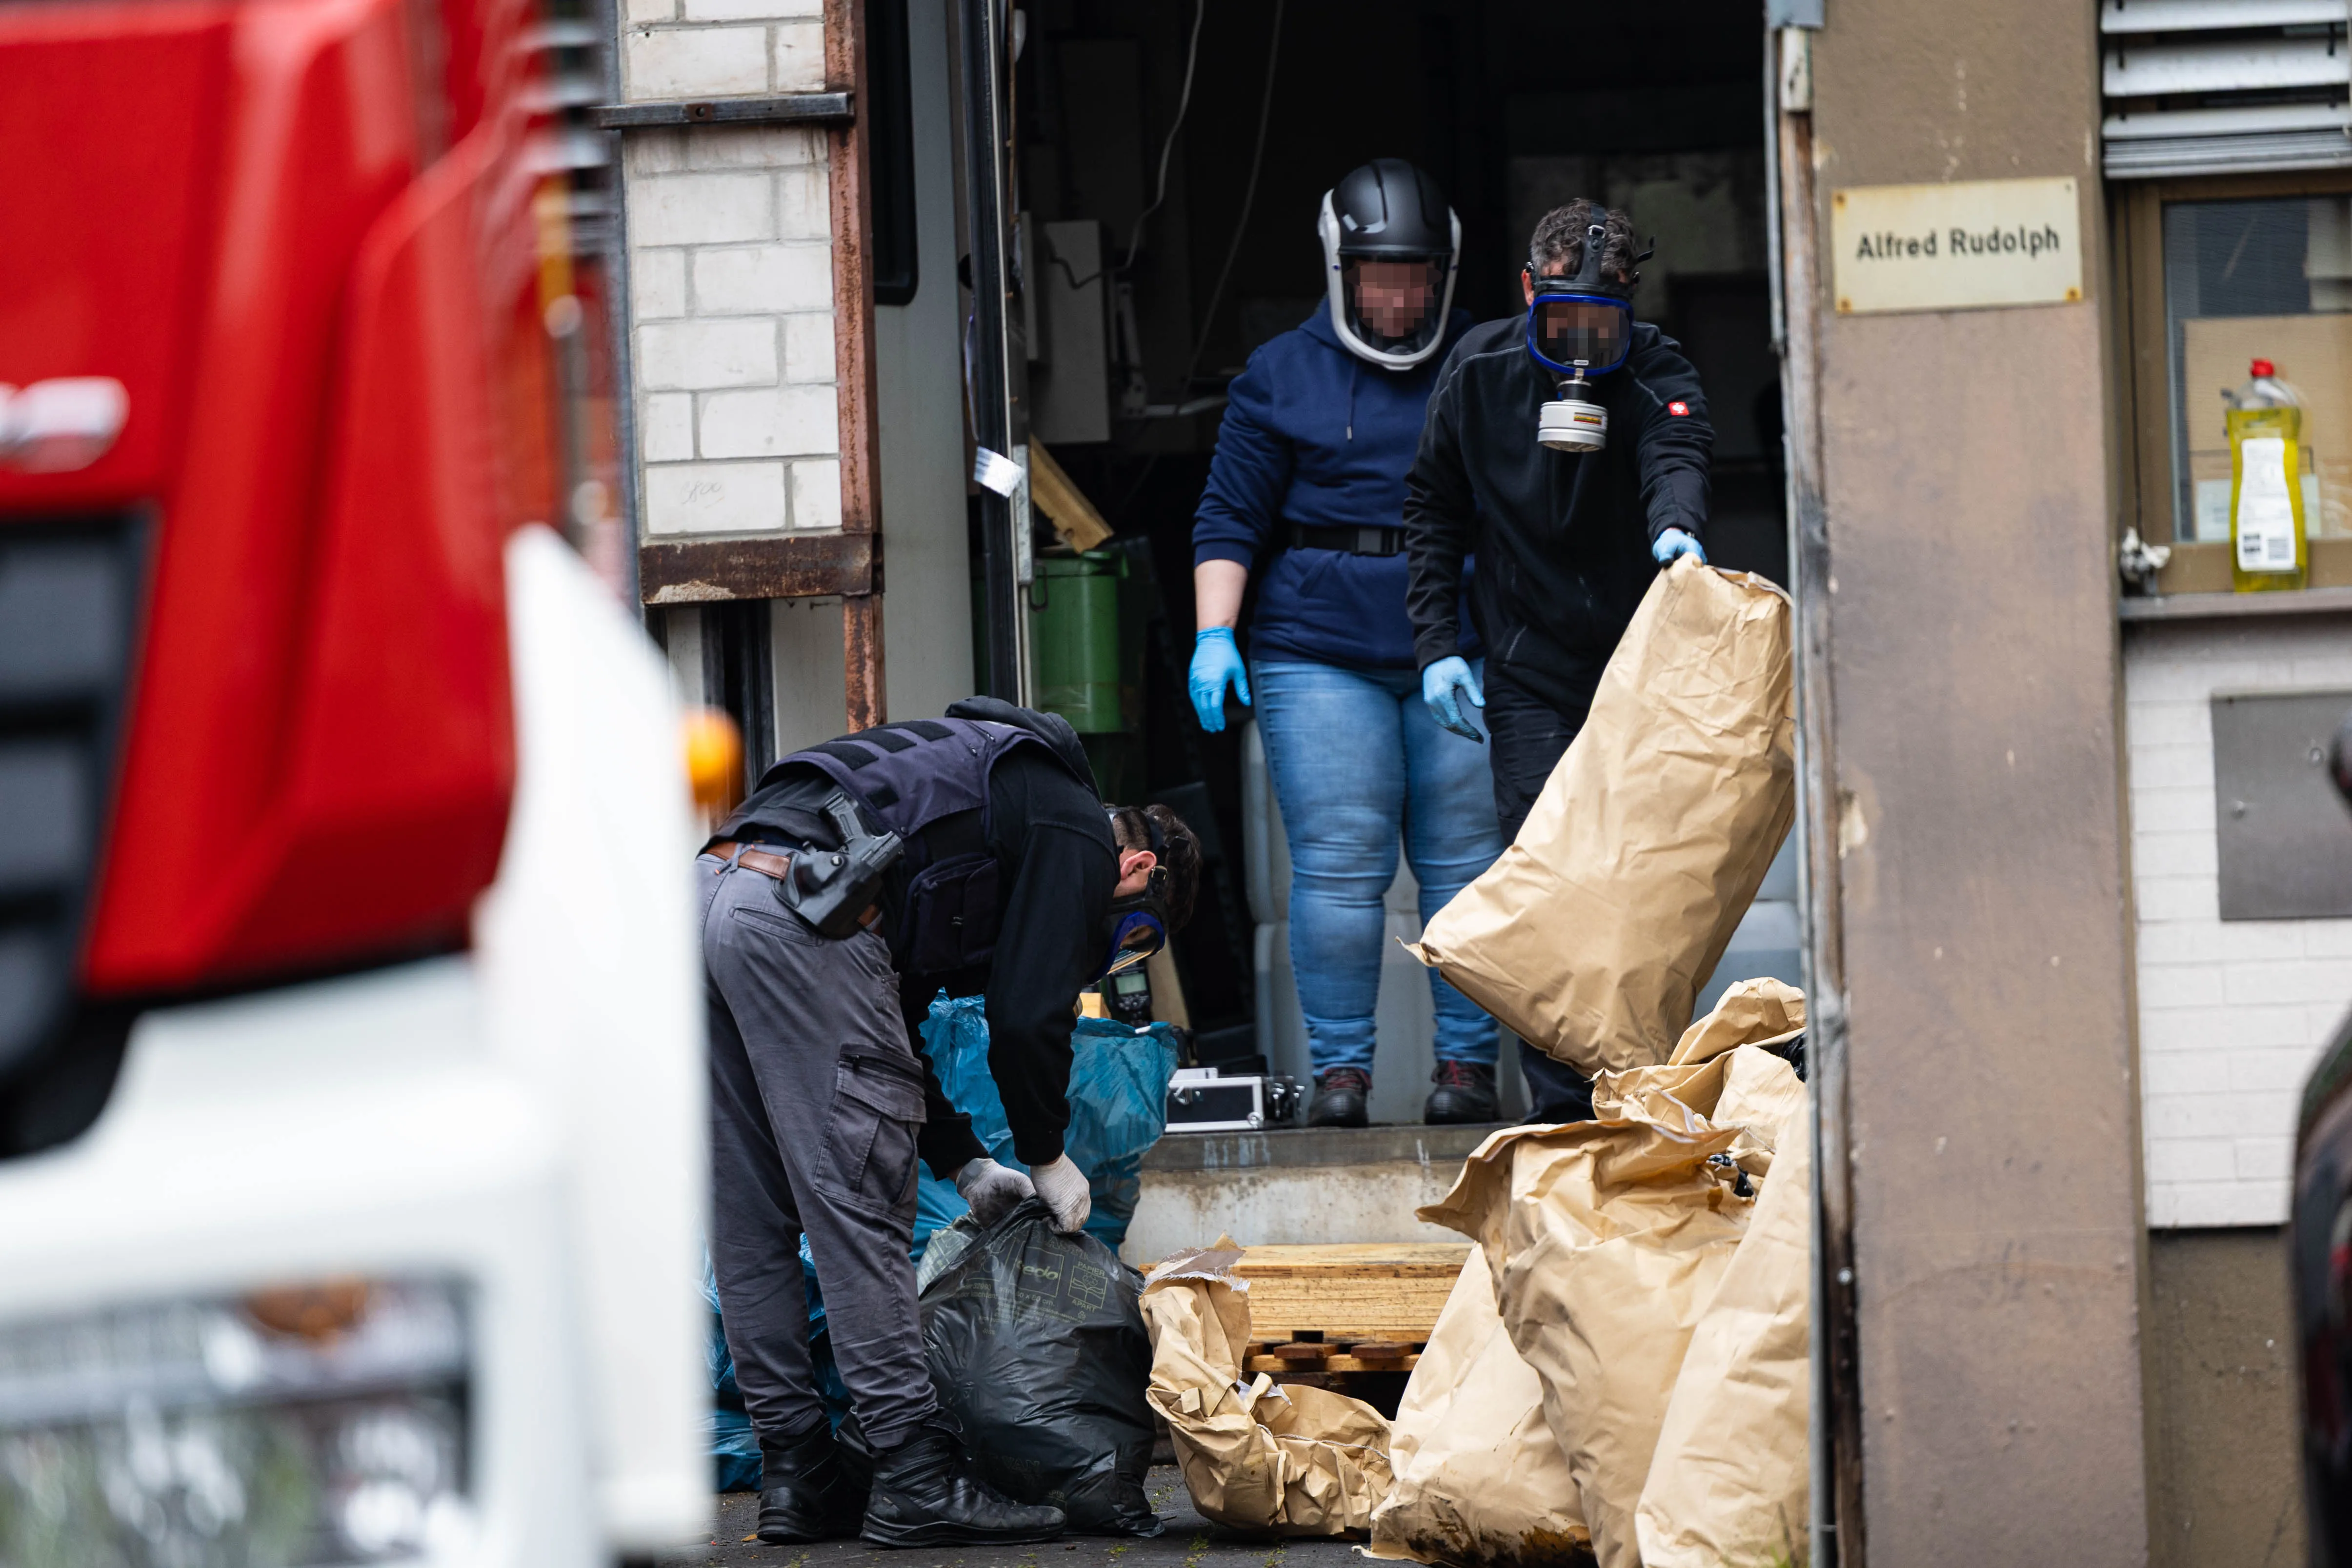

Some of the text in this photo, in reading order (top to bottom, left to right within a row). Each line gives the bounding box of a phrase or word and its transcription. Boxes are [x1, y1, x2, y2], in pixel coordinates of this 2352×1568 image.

[1856, 223, 2059, 261] Alfred Rudolph
[1078, 1261, 1105, 1277] PAPIER
[1071, 1299, 1097, 1312] APART
[1002, 1455, 1040, 1471] VAN
